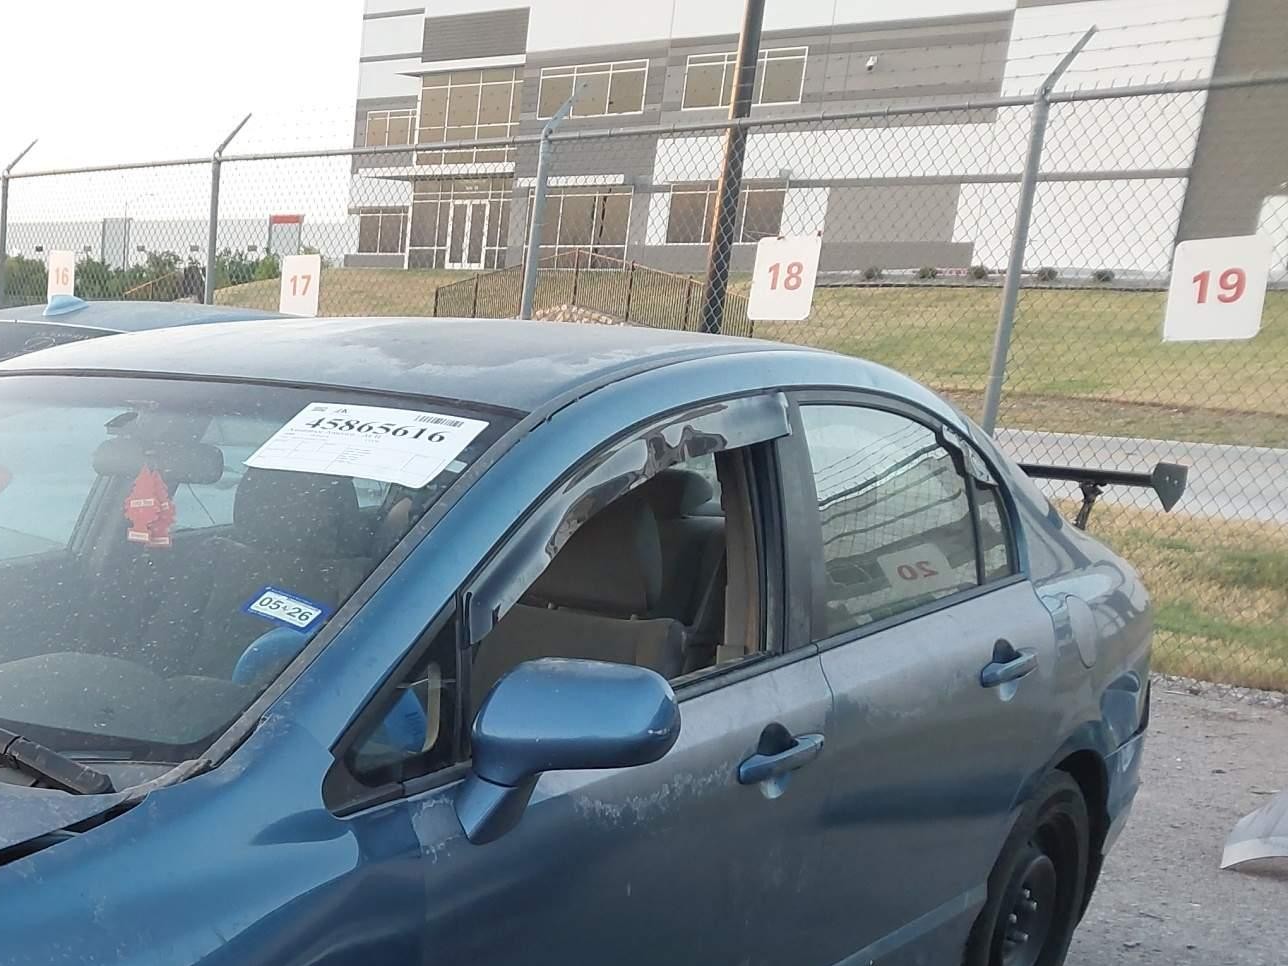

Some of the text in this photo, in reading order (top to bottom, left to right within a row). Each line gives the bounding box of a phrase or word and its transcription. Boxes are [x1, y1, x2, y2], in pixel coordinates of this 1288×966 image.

[55, 267, 69, 286] 16
[290, 275, 311, 296] 17
[768, 262, 803, 290] 18
[1192, 267, 1246, 304] 19
[305, 416, 448, 443] 45865616
[259, 596, 313, 621] 05 26
